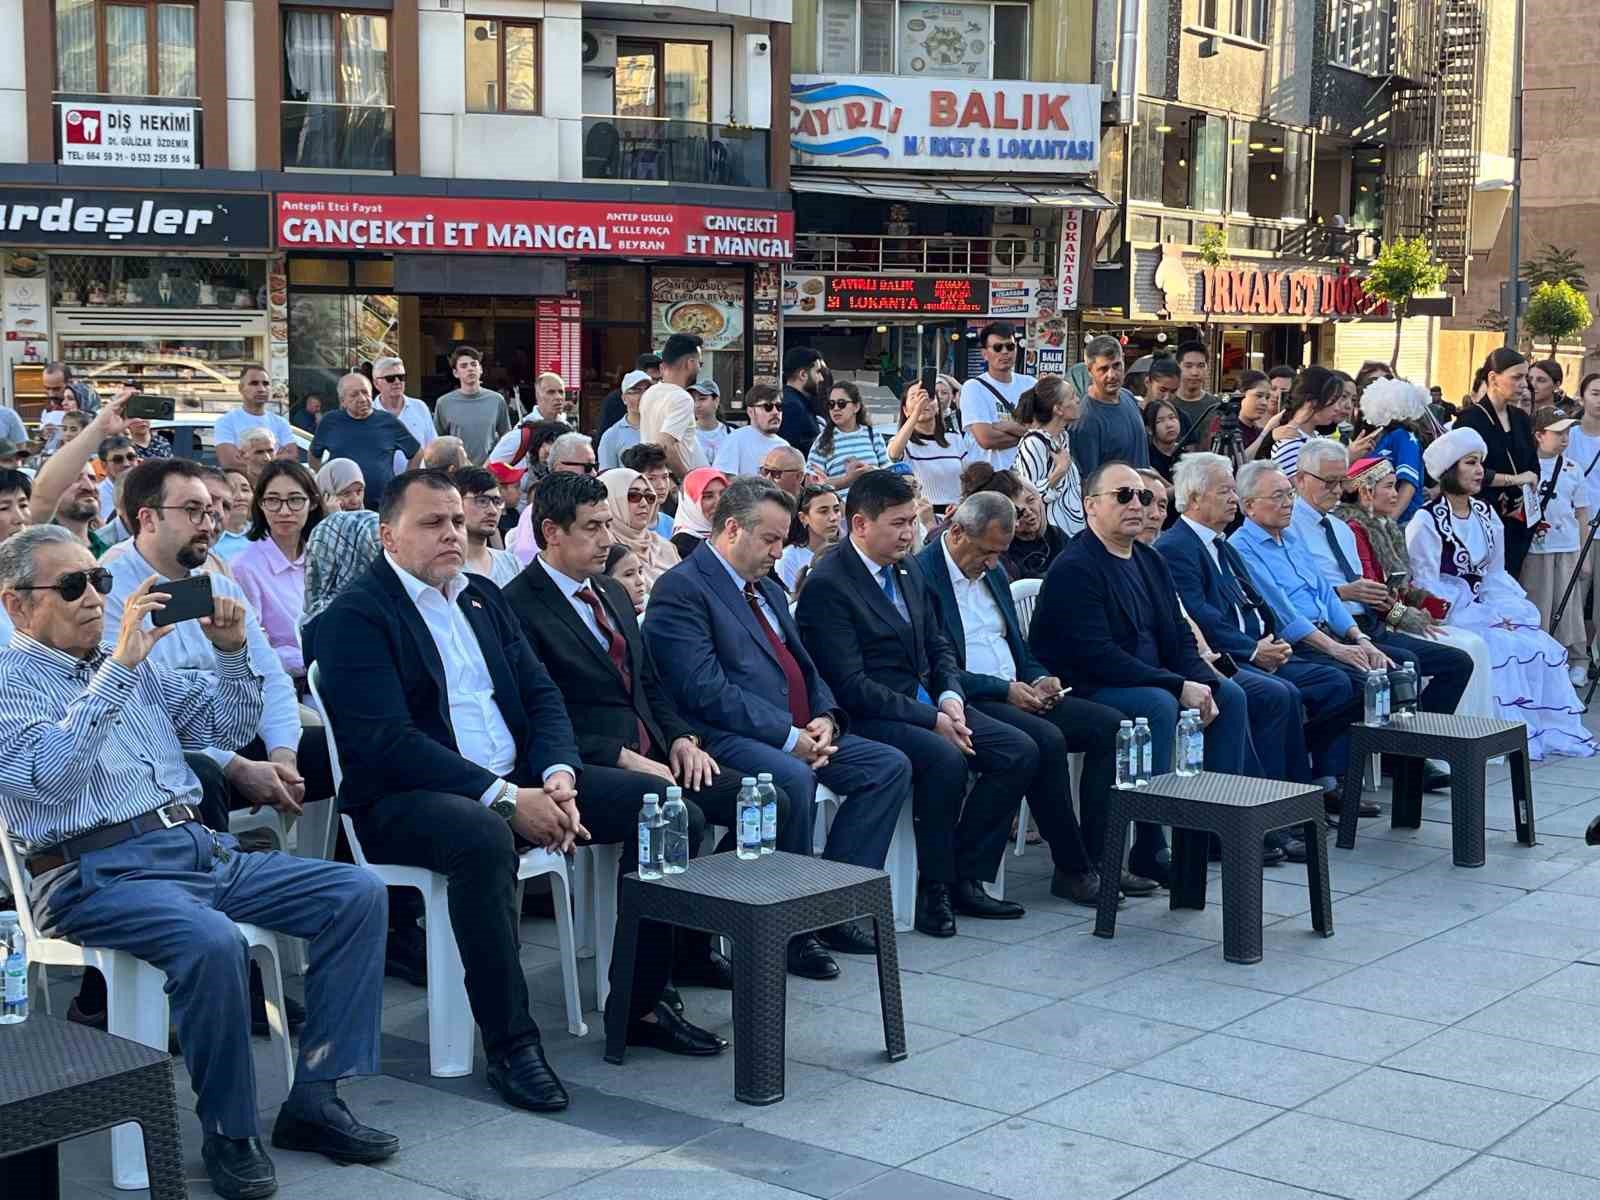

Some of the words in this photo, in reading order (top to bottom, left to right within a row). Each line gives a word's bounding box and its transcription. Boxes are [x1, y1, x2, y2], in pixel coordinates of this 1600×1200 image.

[107, 110, 132, 133] DİŞ
[140, 113, 190, 132] HEKİMİ
[929, 90, 1071, 131] BALIK
[979, 137, 990, 158] &
[998, 138, 1094, 160] LOKANTASI
[282, 201, 325, 213] Antepli
[327, 202, 350, 212] Etci
[352, 203, 383, 214] Fayat
[606, 213, 639, 222] ANTEP
[282, 214, 434, 249] CANÇEKTİ
[444, 222, 480, 247] ET
[487, 222, 612, 250] MANGAL
[612, 226, 641, 235] KELLE
[643, 227, 671, 236] PAÇA
[704, 215, 777, 235] CANÇEKTİ
[618, 240, 665, 250] BEYRAN
[687, 235, 711, 254] ET
[715, 236, 794, 258] MANGAL
[1063, 209, 1077, 305] LOKANTASI
[1203, 267, 1285, 313] IRMAK
[1289, 272, 1318, 315] ET
[1042, 351, 1062, 362] BALIK
